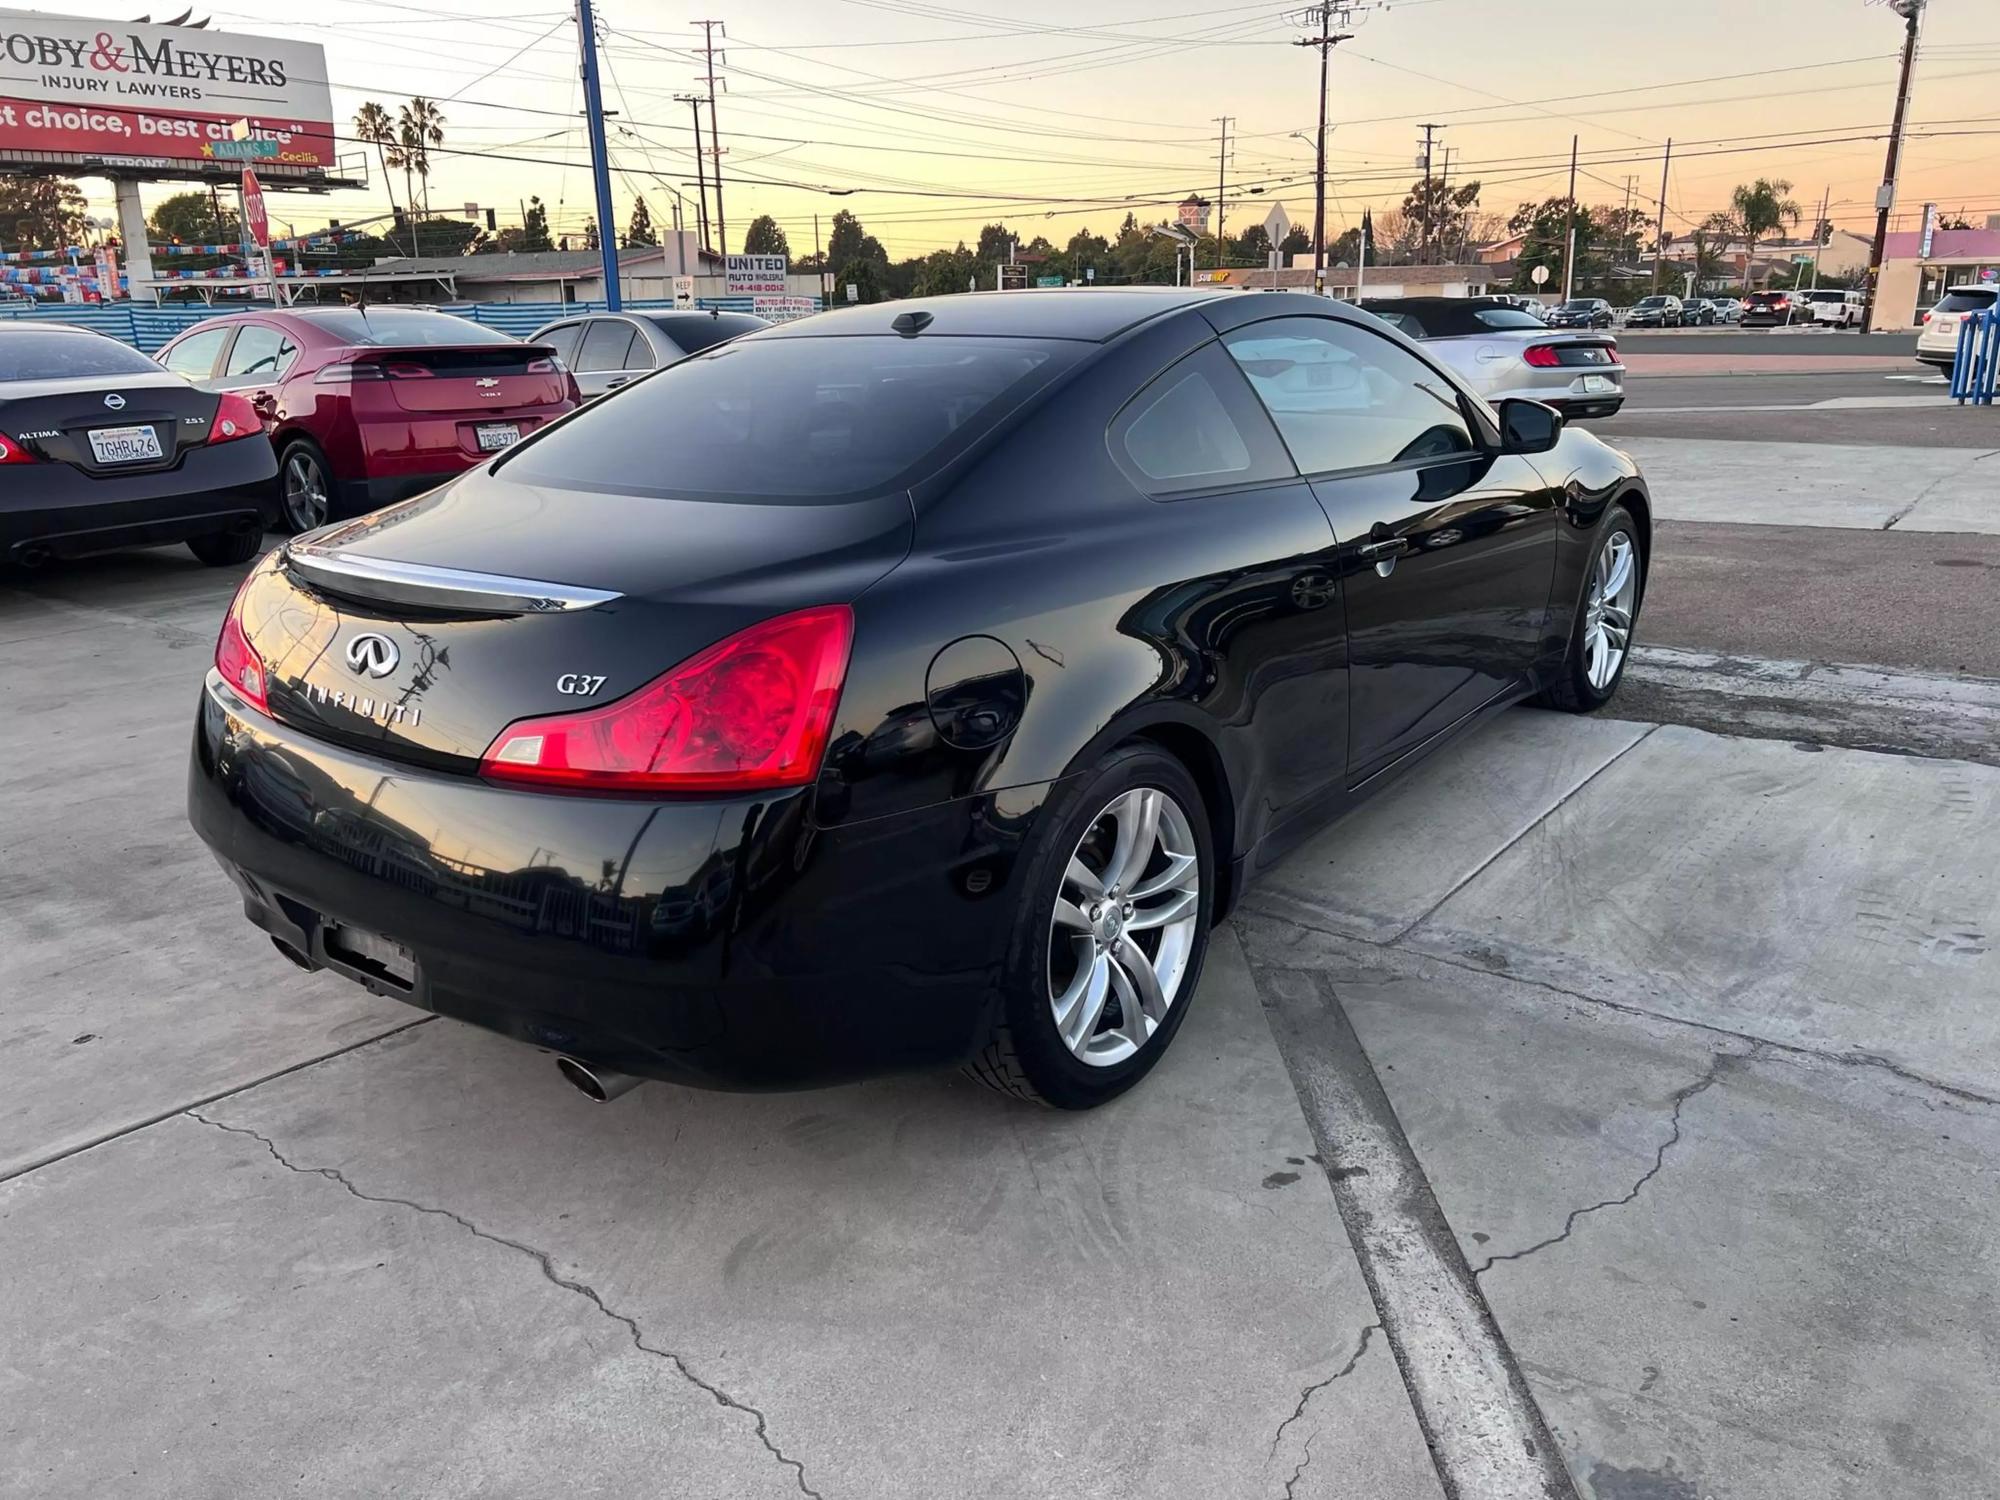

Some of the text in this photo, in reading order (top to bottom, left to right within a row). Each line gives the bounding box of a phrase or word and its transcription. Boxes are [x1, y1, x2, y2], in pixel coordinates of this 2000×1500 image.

[41, 74, 202, 100] INJURY LAWYERS
[25, 105, 132, 138] choice,
[138, 114, 200, 139] best
[219, 142, 274, 157] ADAMS ST
[246, 193, 265, 224] STOP
[728, 257, 784, 271] UNITED
[728, 273, 754, 281] AUTO
[1197, 271, 1230, 282] SUBWAY
[675, 281, 691, 290] KEEP
[19, 430, 60, 440] ALTIMA
[557, 674, 608, 697] G37
[305, 683, 422, 727] INFINITI
